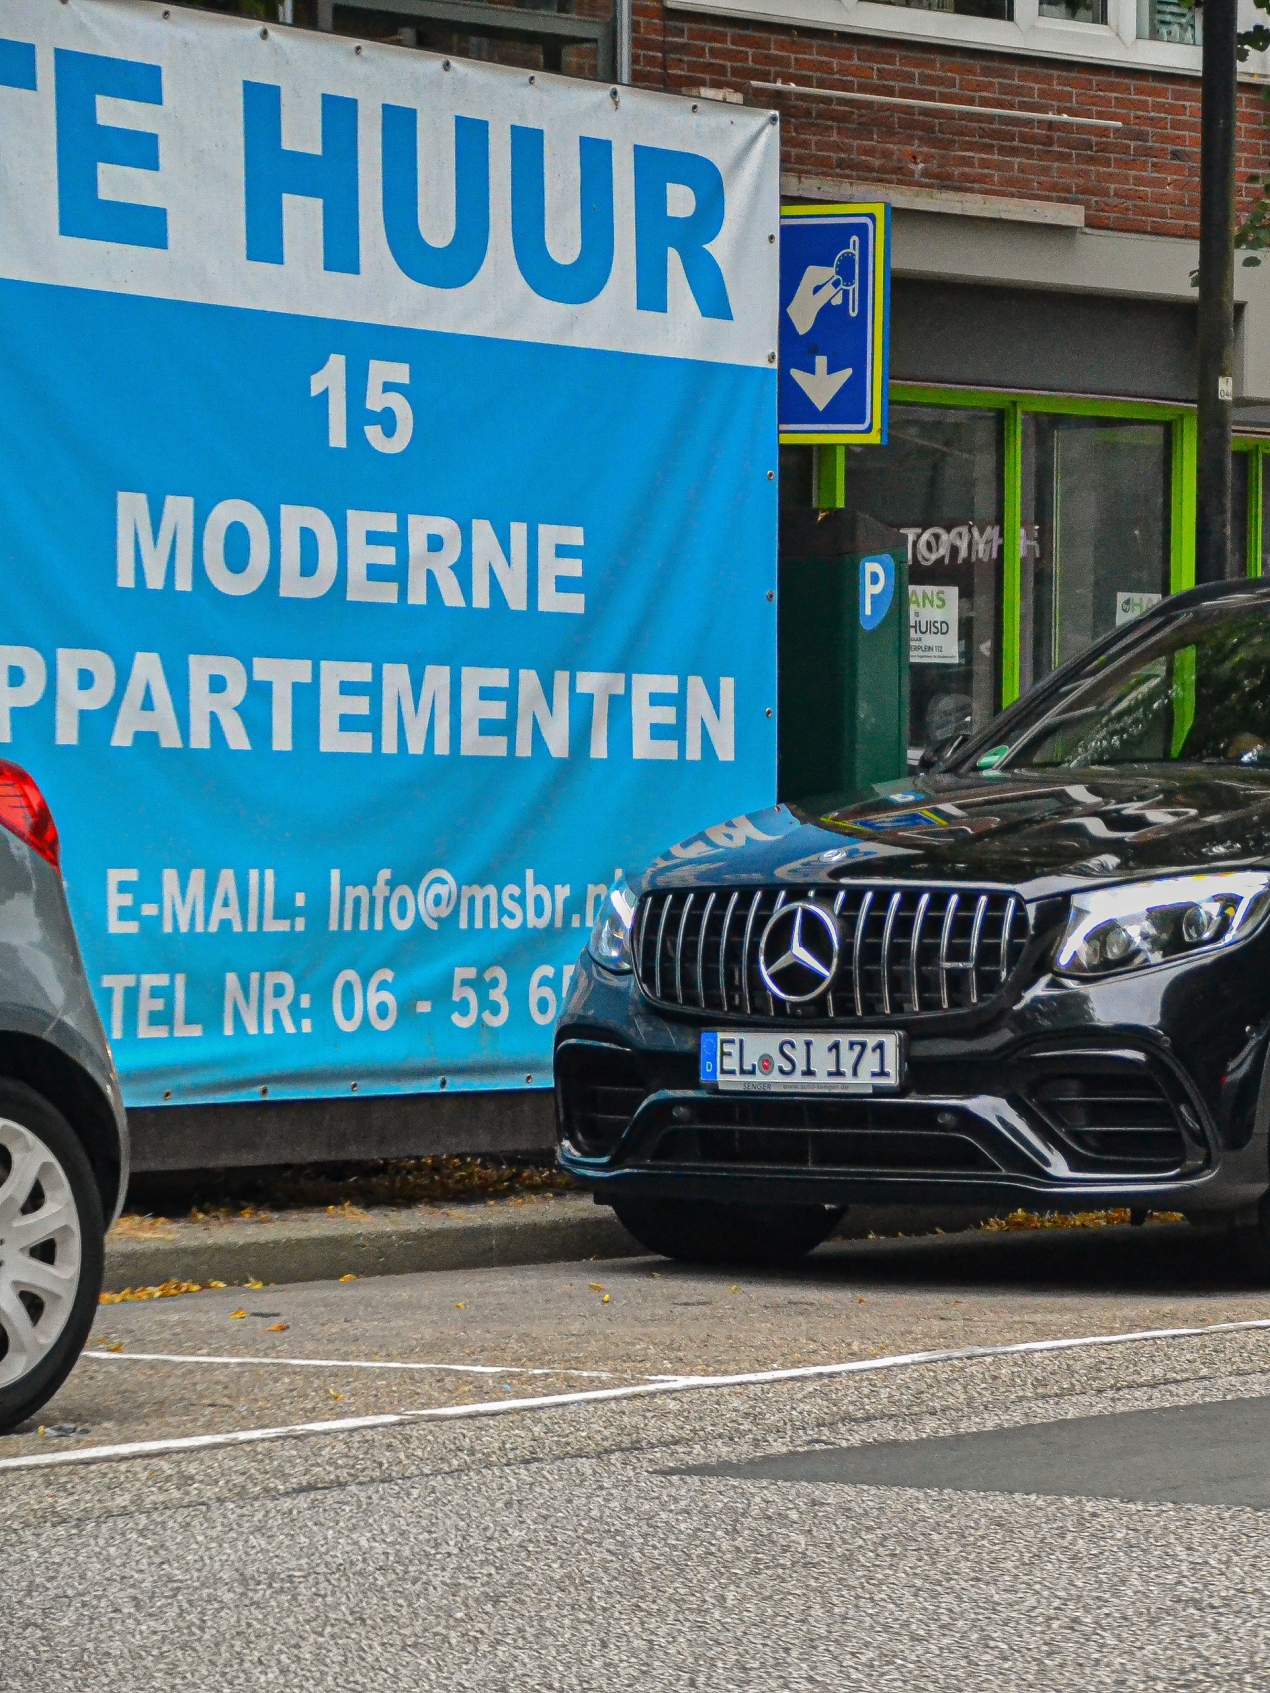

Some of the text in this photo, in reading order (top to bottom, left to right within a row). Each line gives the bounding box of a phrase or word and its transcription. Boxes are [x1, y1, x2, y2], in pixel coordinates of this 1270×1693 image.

[242, 79, 734, 322] HUUR
[310, 354, 414, 454] 15
[115, 491, 586, 614] MODERNE
[865, 562, 885, 616] P
[106, 868, 623, 933] E-MAIL: Info@msbr.n
[102, 973, 204, 1039] TEL
[223, 971, 312, 1036] NR:
[332, 968, 397, 1032] 06
[416, 1000, 431, 1012] -
[451, 966, 510, 1028] 53
[705, 1037, 892, 1077] D EL SI 171
[742, 1082, 772, 1091] SENGER
